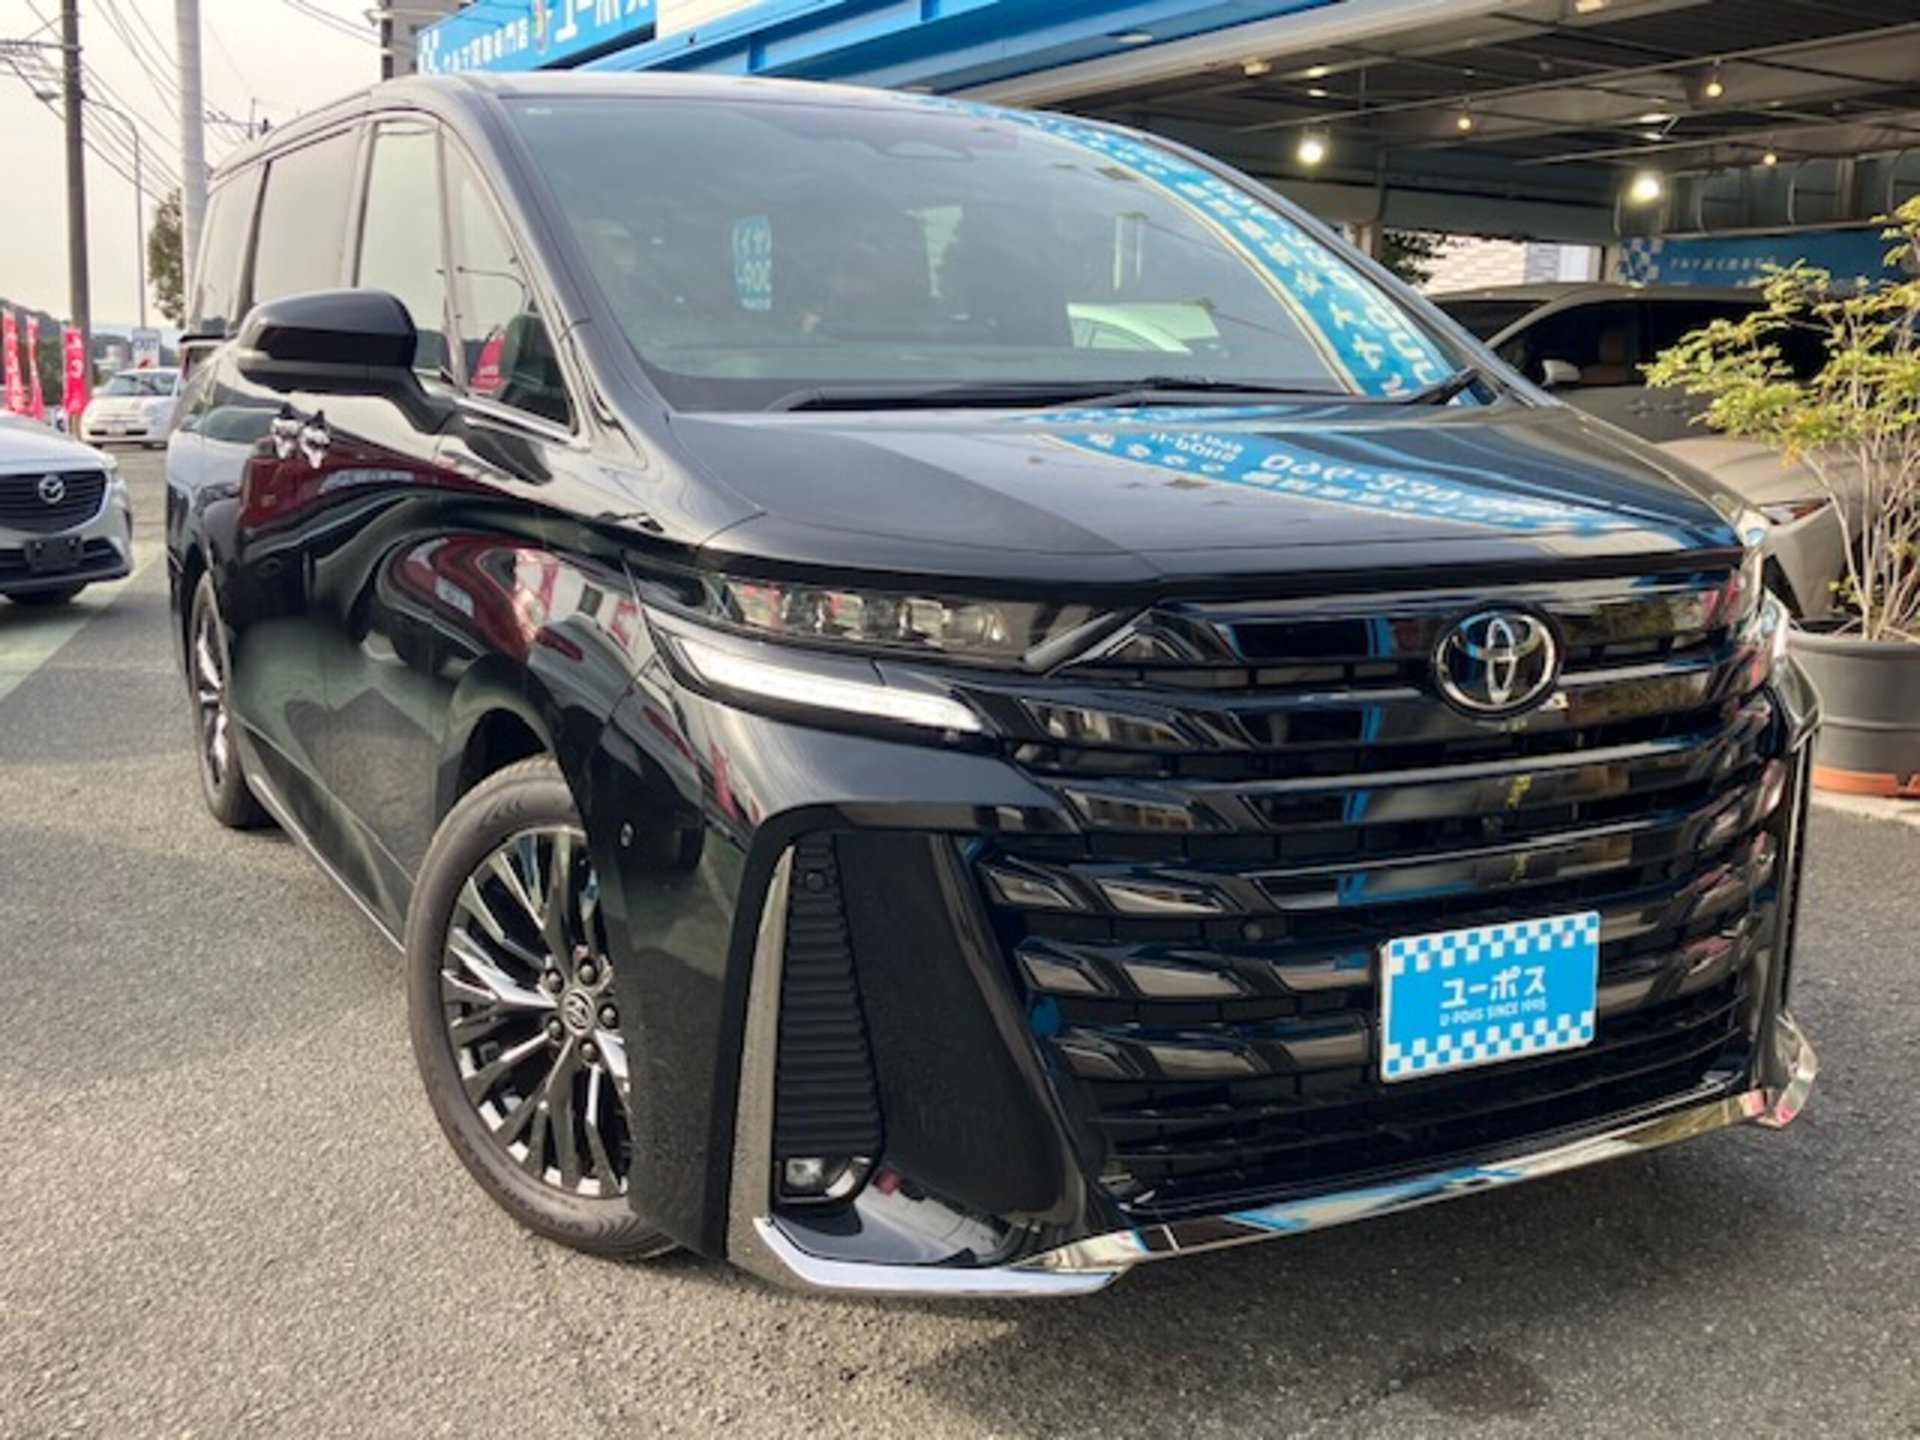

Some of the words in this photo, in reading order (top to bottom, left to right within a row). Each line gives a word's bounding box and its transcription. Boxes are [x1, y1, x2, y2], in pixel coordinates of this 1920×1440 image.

[1440, 965, 1547, 1008] ユーポス
[1487, 1001, 1519, 1020] SINCE
